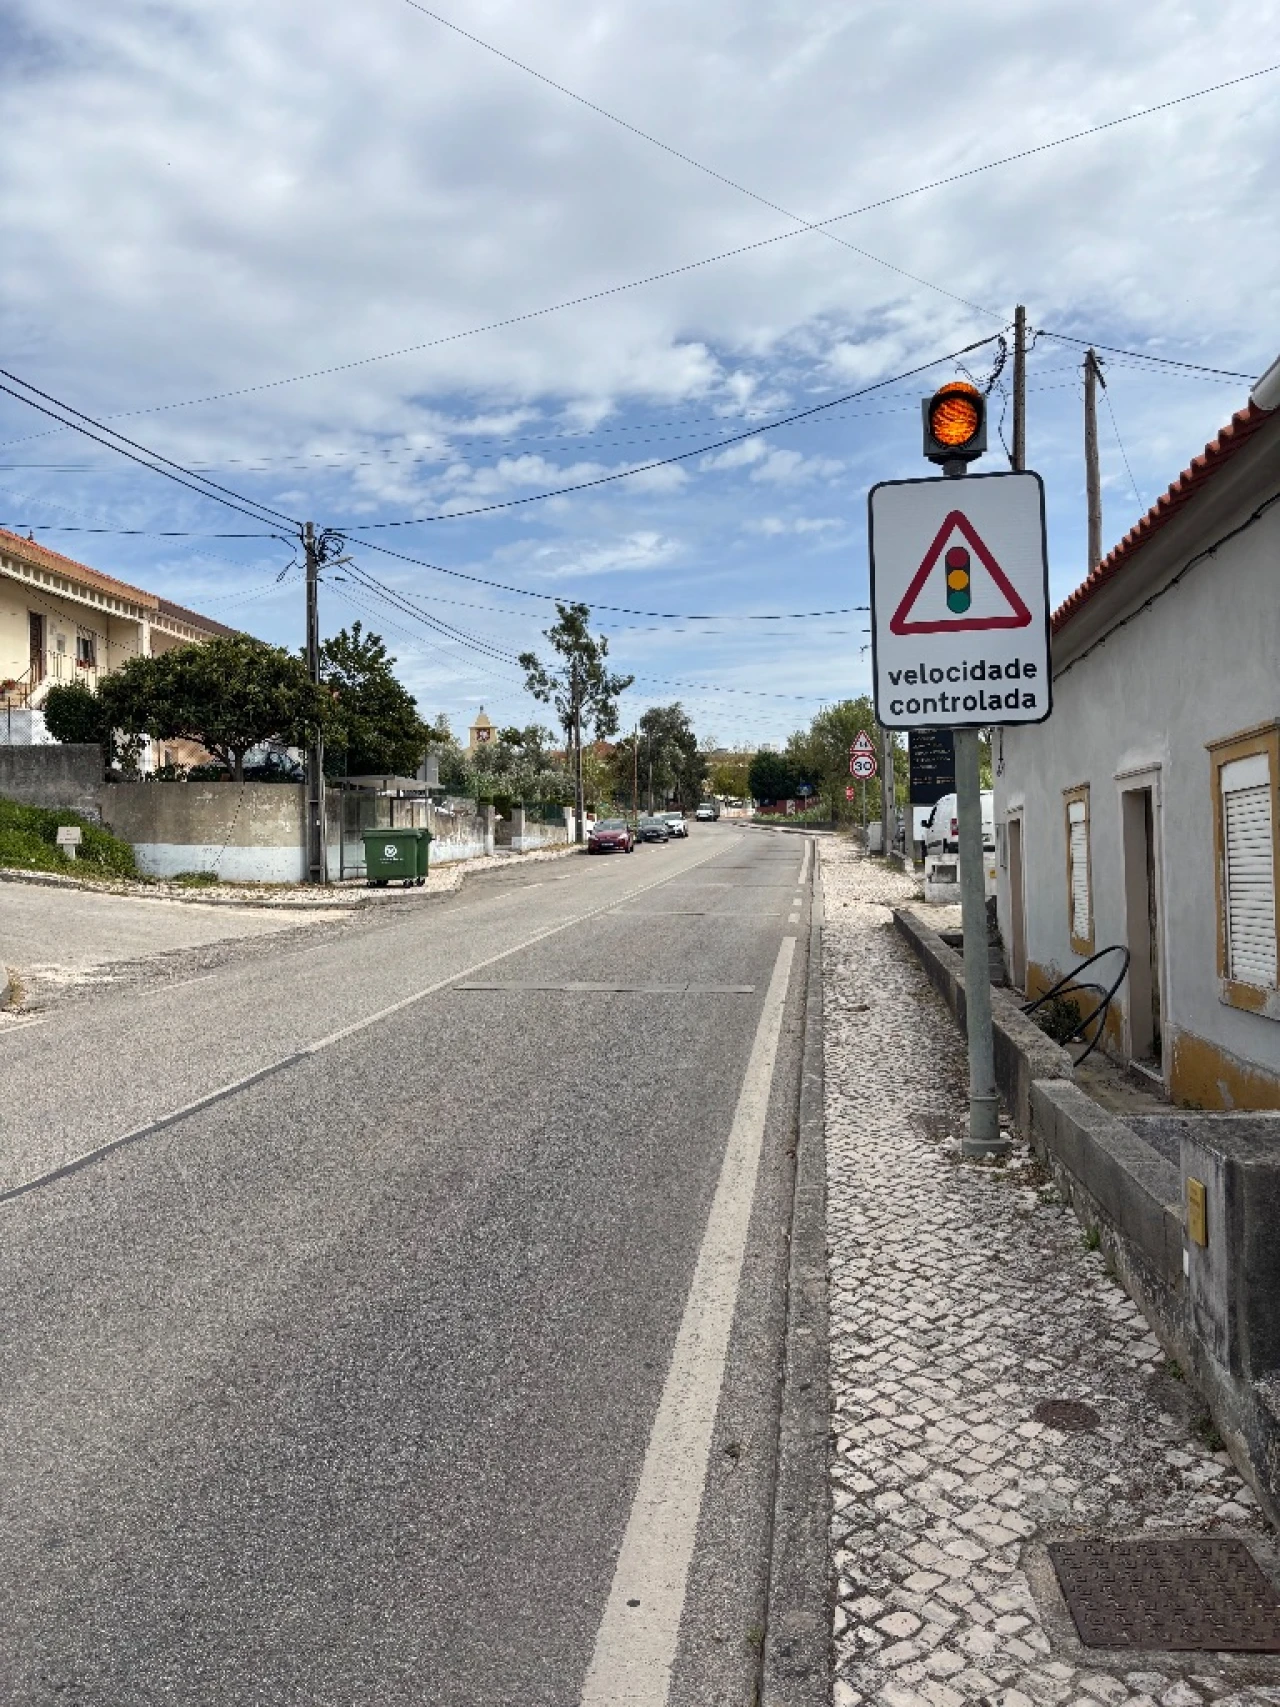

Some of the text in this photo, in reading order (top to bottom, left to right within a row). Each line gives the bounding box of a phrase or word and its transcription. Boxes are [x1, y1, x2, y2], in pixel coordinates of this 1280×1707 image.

[888, 658, 1037, 685] velocidade
[890, 688, 1037, 715] controlada
[855, 762, 872, 771] 30
